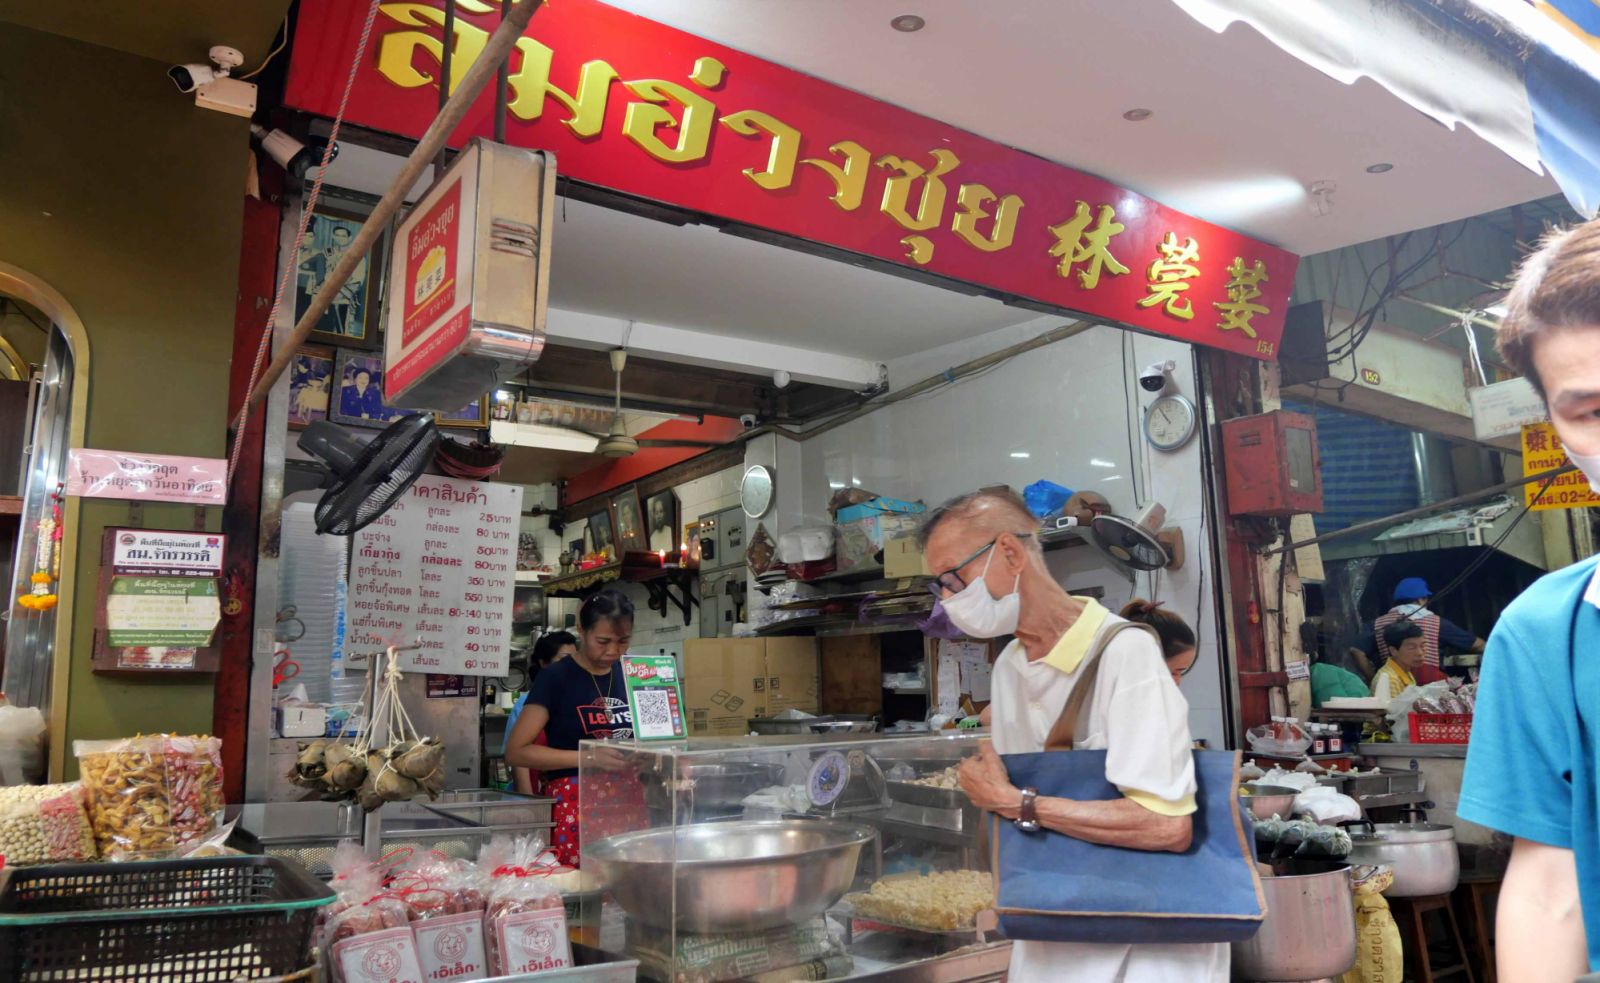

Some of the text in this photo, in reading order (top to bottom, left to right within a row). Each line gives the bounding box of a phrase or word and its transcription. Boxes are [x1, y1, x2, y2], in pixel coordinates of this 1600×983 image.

[1256, 340, 1275, 356] 154
[1364, 371, 1380, 385] 152
[412, 484, 487, 506] าคาสินค้า
[477, 528, 489, 538] 80
[492, 531, 510, 540] บาท
[424, 539, 448, 551] ลูกละ
[421, 551, 463, 567] กล่องละ
[467, 576, 485, 586] 350
[488, 578, 506, 588] บาท
[464, 592, 483, 603] 550
[486, 594, 504, 604] บาท
[485, 610, 503, 620] บาท
[467, 625, 480, 636] 80
[483, 627, 502, 637] บาท
[415, 639, 444, 649] วดละ
[464, 643, 479, 652] 40
[482, 645, 500, 655] บาท
[464, 659, 477, 670] 60
[481, 660, 499, 671] บาท
